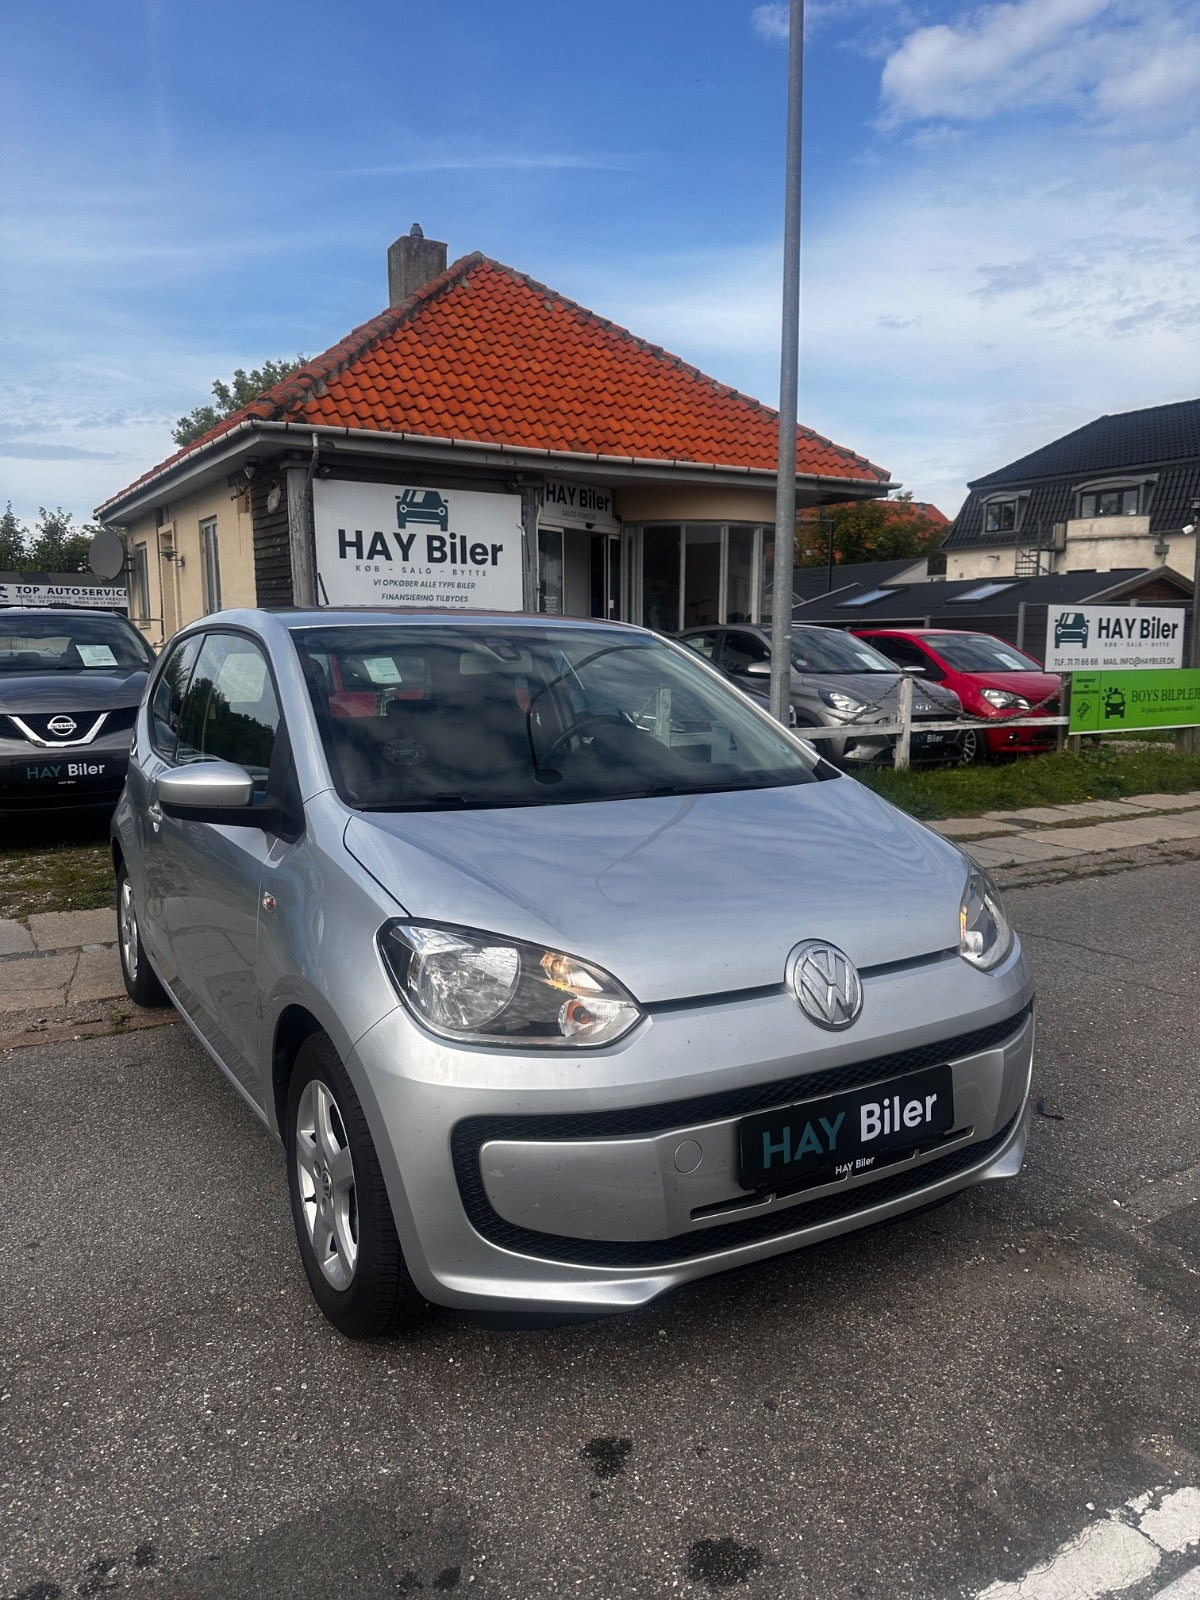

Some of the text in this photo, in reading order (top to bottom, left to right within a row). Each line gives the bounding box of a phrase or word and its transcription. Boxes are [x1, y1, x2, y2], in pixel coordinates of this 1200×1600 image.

[546, 482, 610, 511] HAY Biler
[338, 529, 503, 566] HAY Biler
[355, 564, 380, 573] KØB
[402, 566, 432, 575] SALG
[452, 569, 487, 577] BYTTE
[15, 586, 40, 594] TOP
[373, 578, 381, 586] VI
[420, 580, 438, 588] ALLE
[438, 581, 456, 589] TYPE
[456, 581, 476, 589] BILER
[381, 593, 469, 603] FINANSIERING TILBYDES
[1098, 616, 1178, 639] HAY Biler
[1132, 689, 1159, 702] BOYS
[26, 763, 105, 779] HAY Biler
[762, 1093, 937, 1169] HAY Biler
[835, 1156, 875, 1175] HAY Biler
